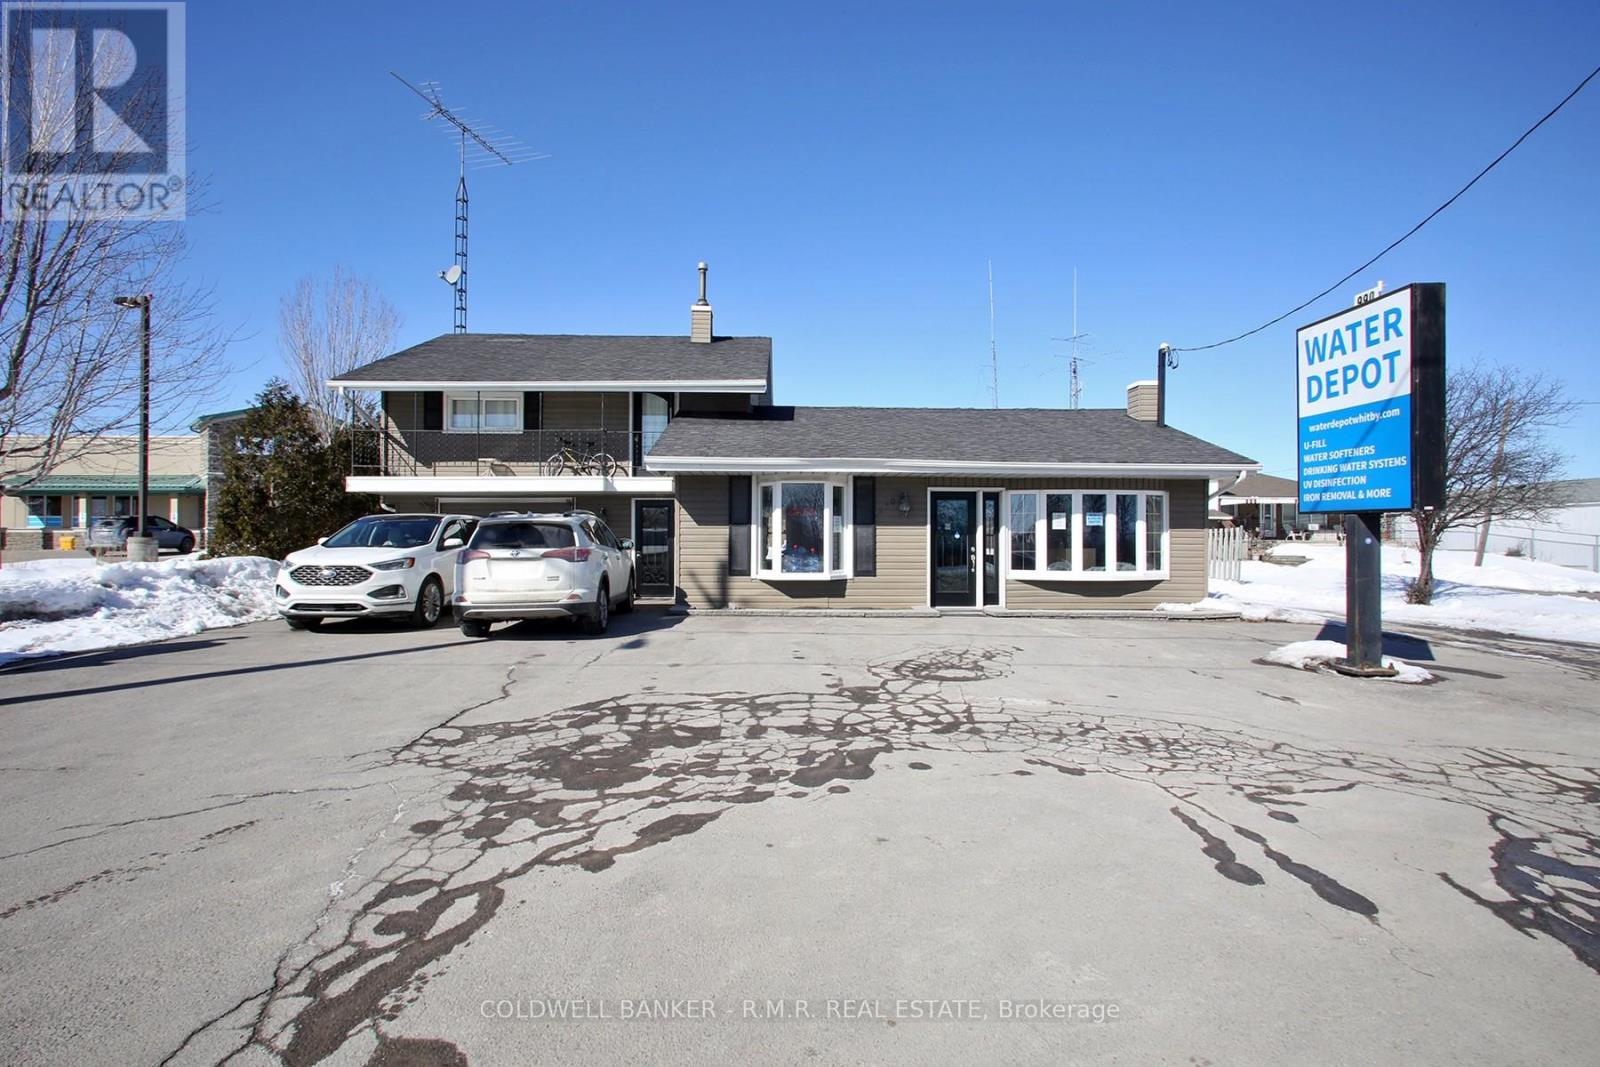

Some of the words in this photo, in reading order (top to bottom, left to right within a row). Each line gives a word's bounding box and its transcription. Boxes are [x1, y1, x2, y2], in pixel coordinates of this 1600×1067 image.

[1304, 307, 1403, 366] WATER
[1307, 349, 1402, 404] DEPOT
[1308, 408, 1400, 433] waterdepotwhitby.com
[1303, 439, 1327, 450] U-FILL
[1303, 452, 1328, 463] WATER
[1329, 445, 1376, 460] SOFTENERS
[1303, 464, 1338, 476] DRINKING
[1339, 461, 1367, 473] WATER
[1368, 456, 1407, 470] SYSTEMS
[1303, 480, 1312, 489] UV
[1313, 475, 1367, 488] DISINFECTION
[1303, 493, 1320, 502] IRON
[1321, 490, 1356, 501] REMOVAL
[1358, 490, 1365, 499] &
[1366, 488, 1392, 499] MORE
